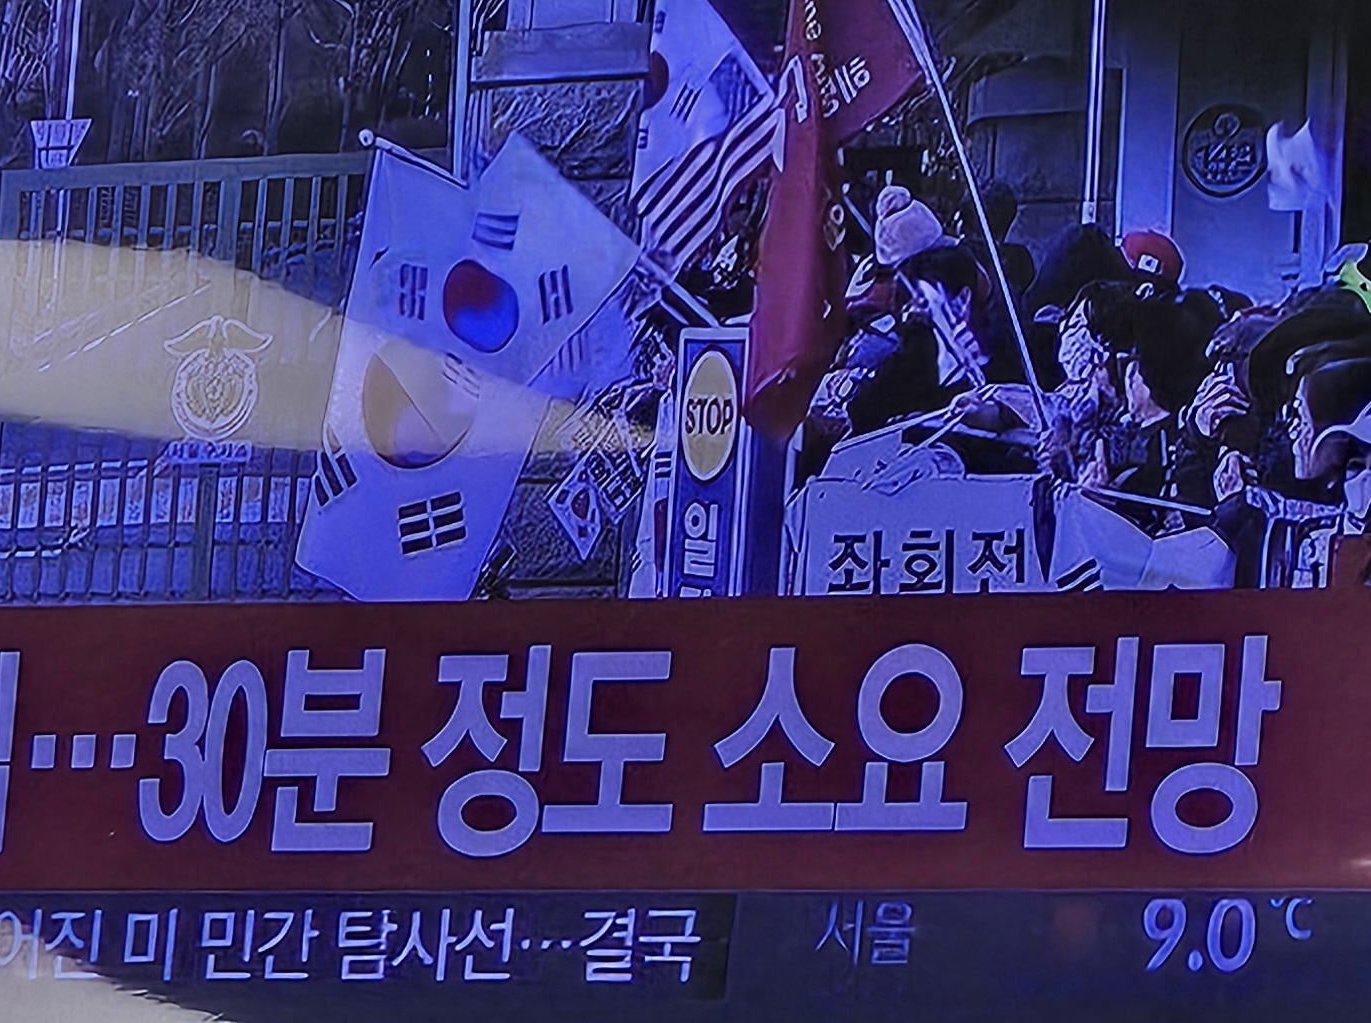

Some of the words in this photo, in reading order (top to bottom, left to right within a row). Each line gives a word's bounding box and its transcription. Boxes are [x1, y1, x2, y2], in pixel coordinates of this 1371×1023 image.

[685, 396, 734, 436] STOP
[421, 644, 672, 858] 정도
[702, 642, 969, 832] 소요
[1003, 634, 1282, 855] 전망
[122, 907, 179, 981] 미
[200, 907, 319, 980] 민간
[814, 898, 917, 967] 서울
